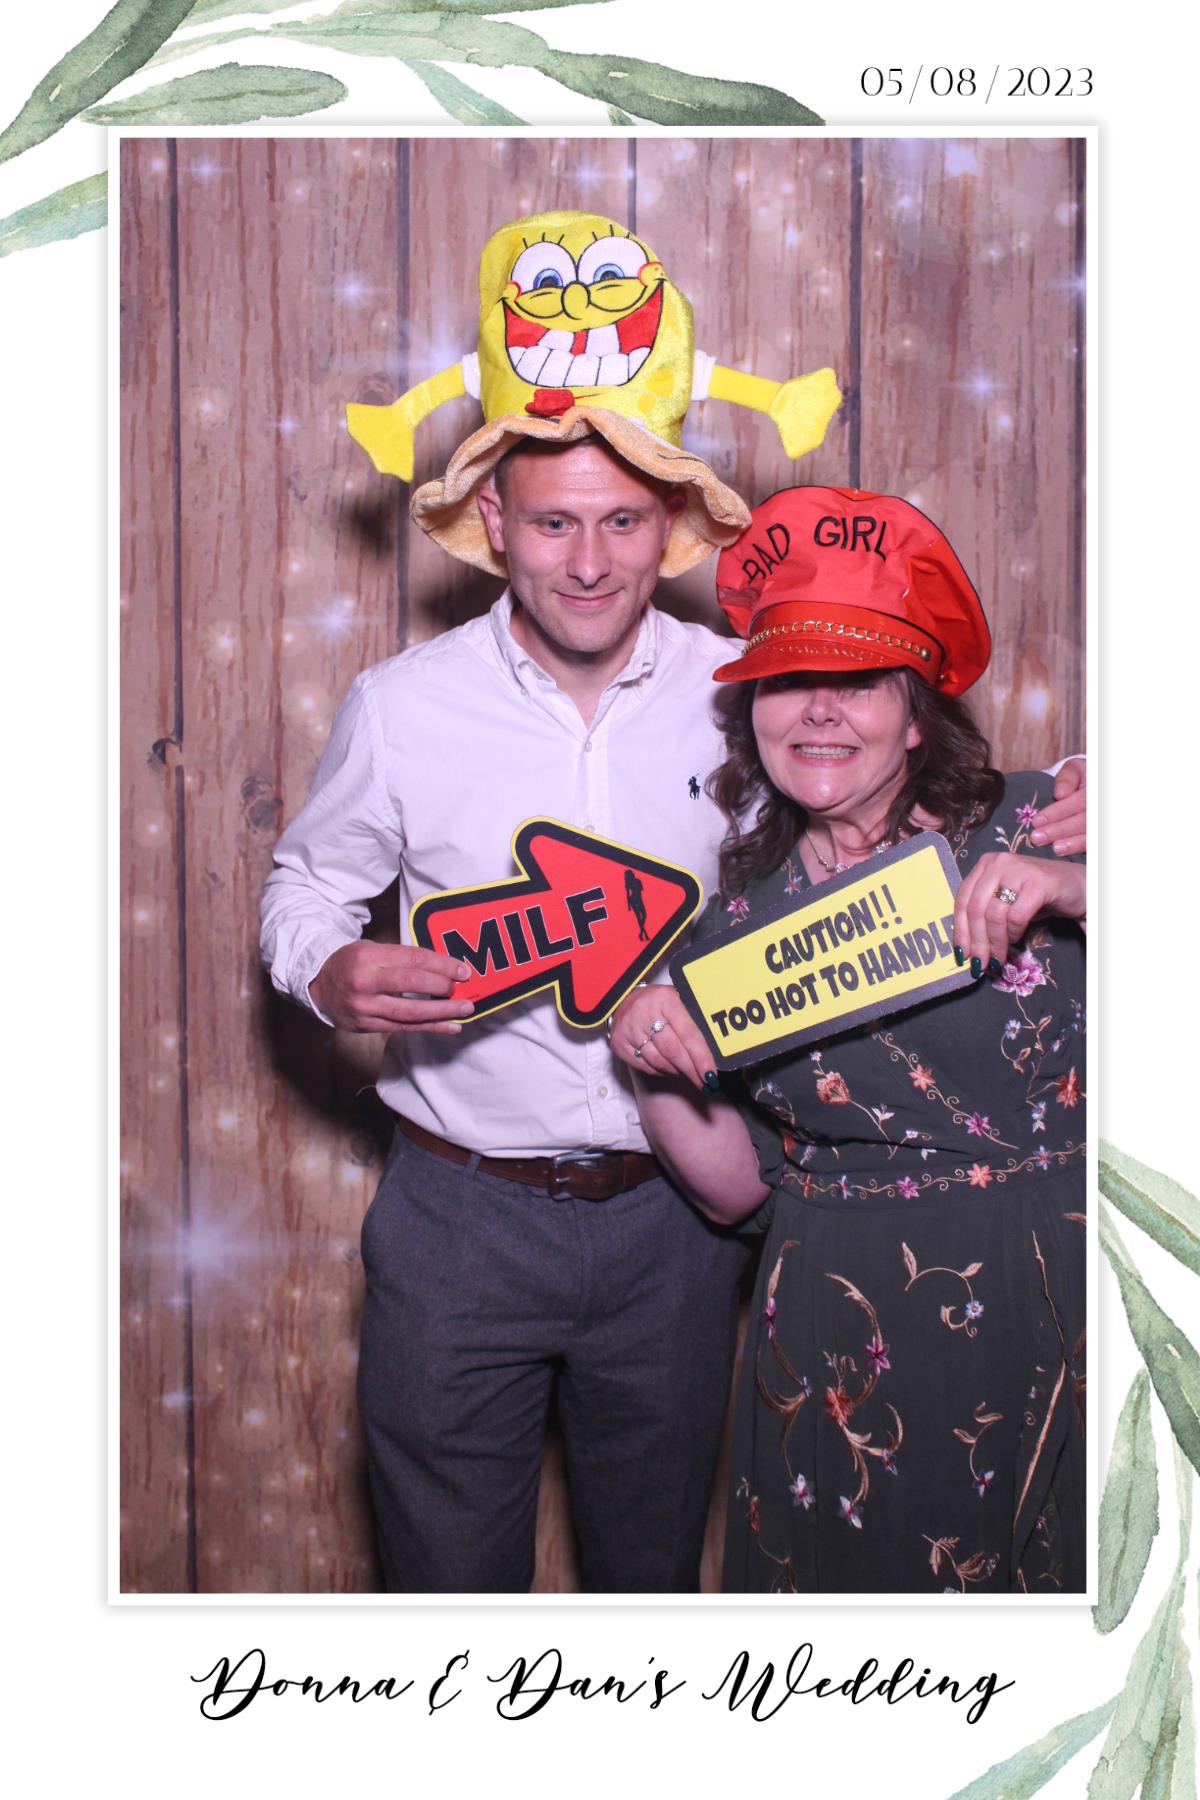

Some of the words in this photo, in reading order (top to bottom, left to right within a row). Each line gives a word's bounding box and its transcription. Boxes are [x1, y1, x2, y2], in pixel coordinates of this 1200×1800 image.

[741, 523, 791, 583] BAD
[813, 516, 888, 563] GIRL
[442, 886, 608, 977] MILF
[765, 883, 904, 974] CAUTION!!
[711, 999, 766, 1038] TOO
[766, 969, 817, 1020] HOT
[819, 960, 860, 998] TO
